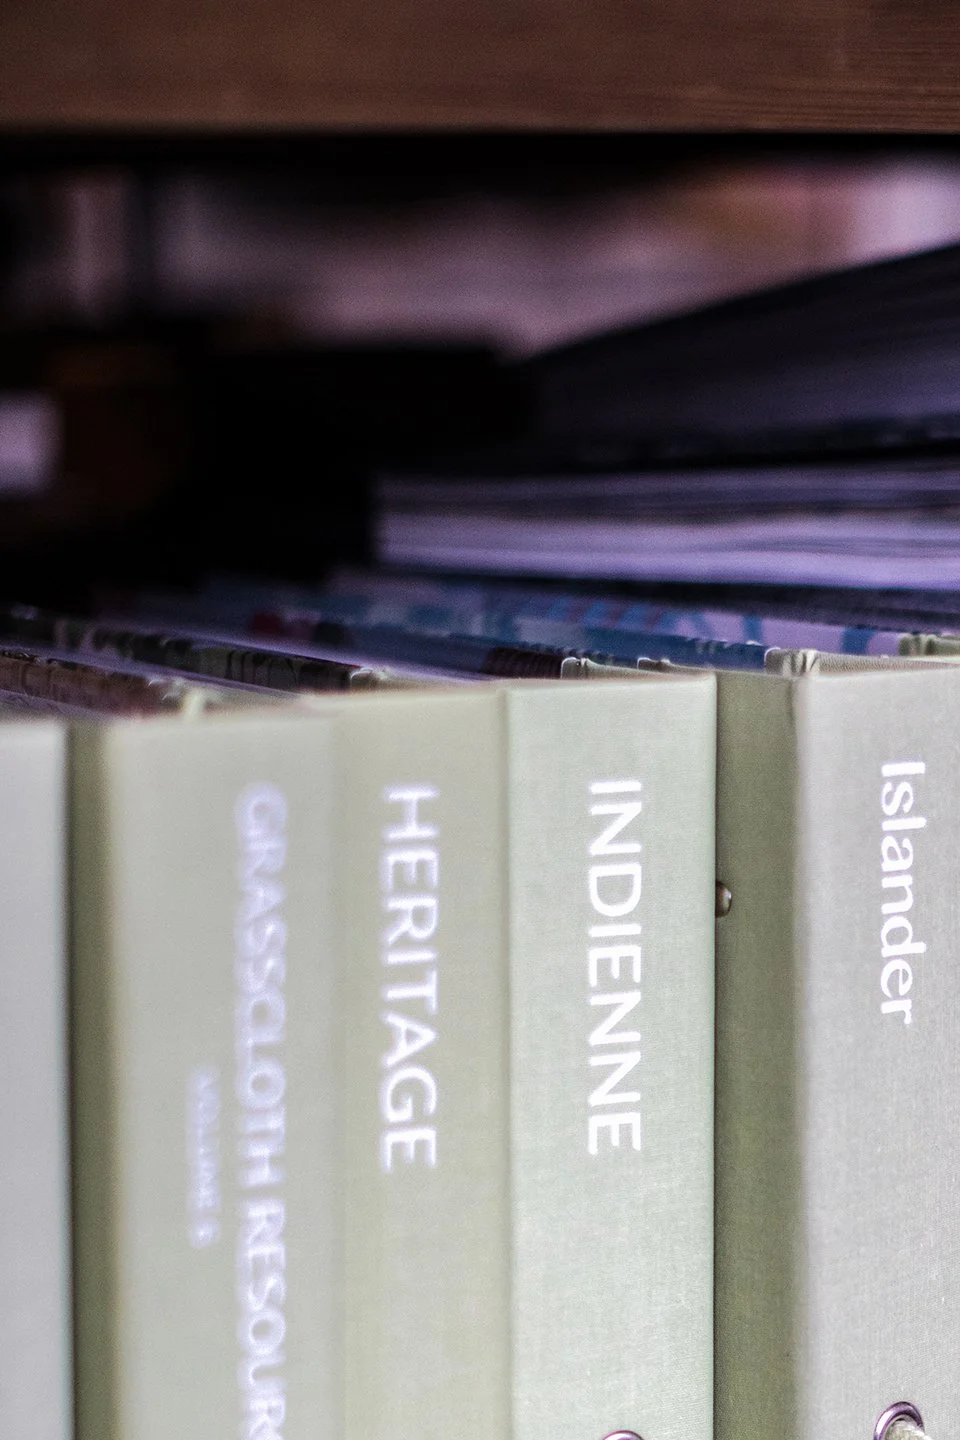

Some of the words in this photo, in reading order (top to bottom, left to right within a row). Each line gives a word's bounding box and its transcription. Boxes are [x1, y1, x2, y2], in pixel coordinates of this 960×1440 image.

[237, 783, 286, 1187] GRASSCLOTH
[380, 785, 439, 1172] HERITAGE
[587, 778, 643, 1156] INDIENNE
[880, 760, 927, 1025] Islander
